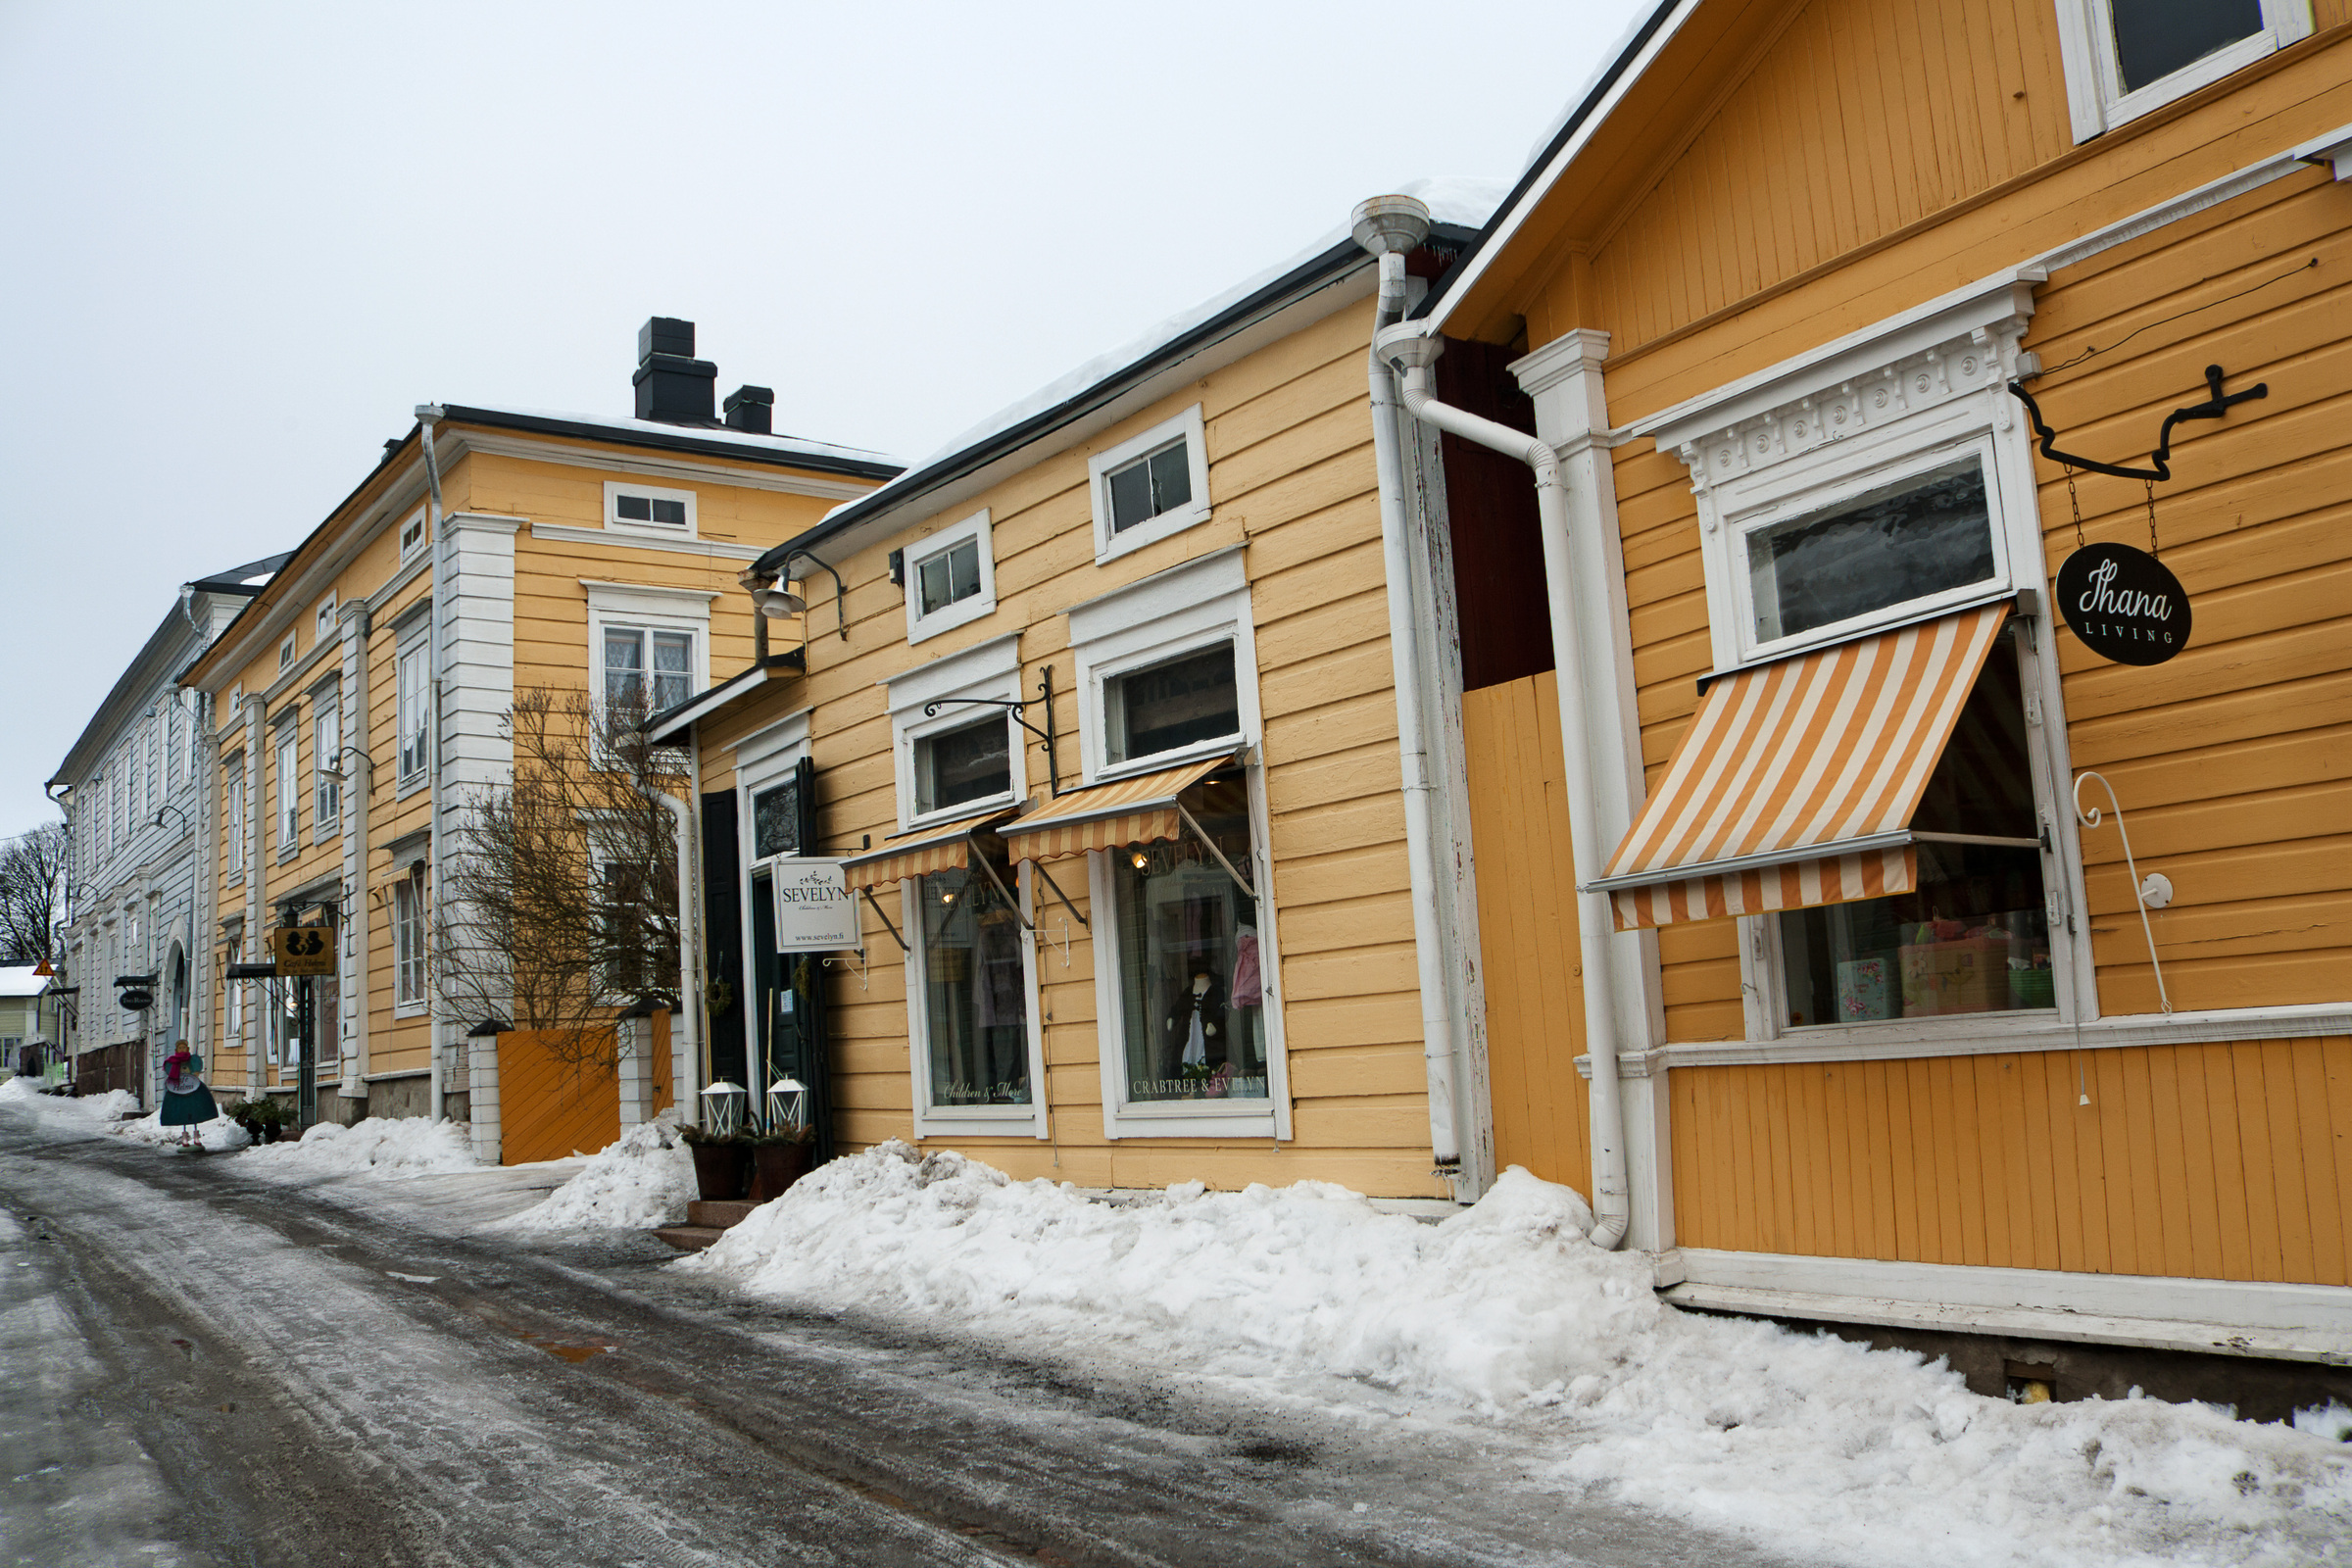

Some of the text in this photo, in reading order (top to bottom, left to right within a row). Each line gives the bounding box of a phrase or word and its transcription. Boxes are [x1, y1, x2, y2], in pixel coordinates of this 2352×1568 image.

[2084, 622, 2173, 644] LIVING
[782, 886, 849, 903] SEVELYN
[795, 931, 845, 942] www.sevelyn.fi
[944, 1079, 981, 1099] Children
[1133, 1075, 1266, 1095] CRABTREE & EVELYN
